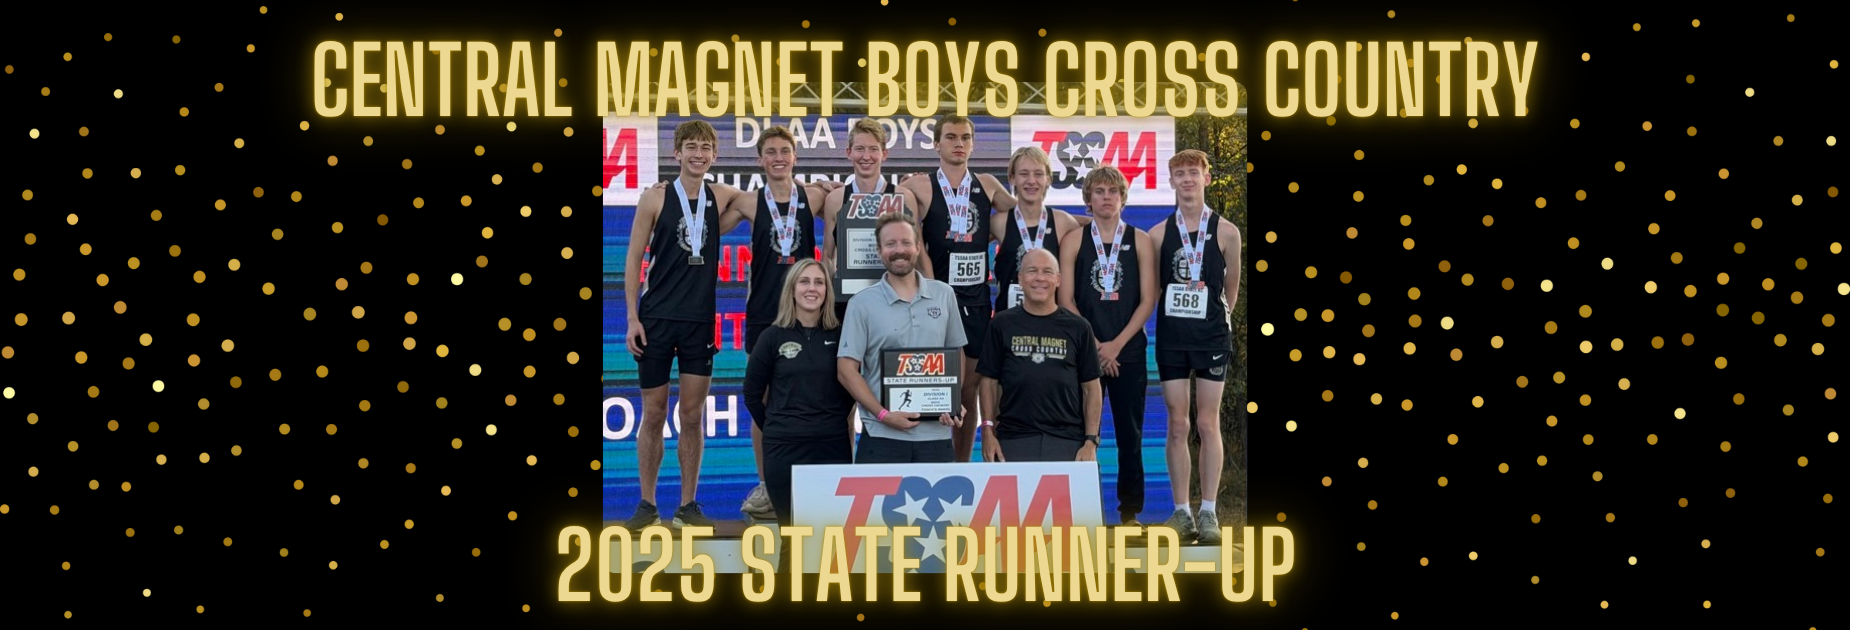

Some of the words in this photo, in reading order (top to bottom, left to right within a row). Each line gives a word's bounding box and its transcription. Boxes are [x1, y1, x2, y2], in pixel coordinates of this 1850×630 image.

[848, 117, 937, 150] OYS
[957, 262, 981, 277] 565
[1173, 293, 1199, 309] 568
[1011, 336, 1039, 346] CENTRAL
[1041, 336, 1067, 348] MAGNET
[1036, 346, 1067, 355] COUNTRY
[896, 353, 945, 376] TSSAA
